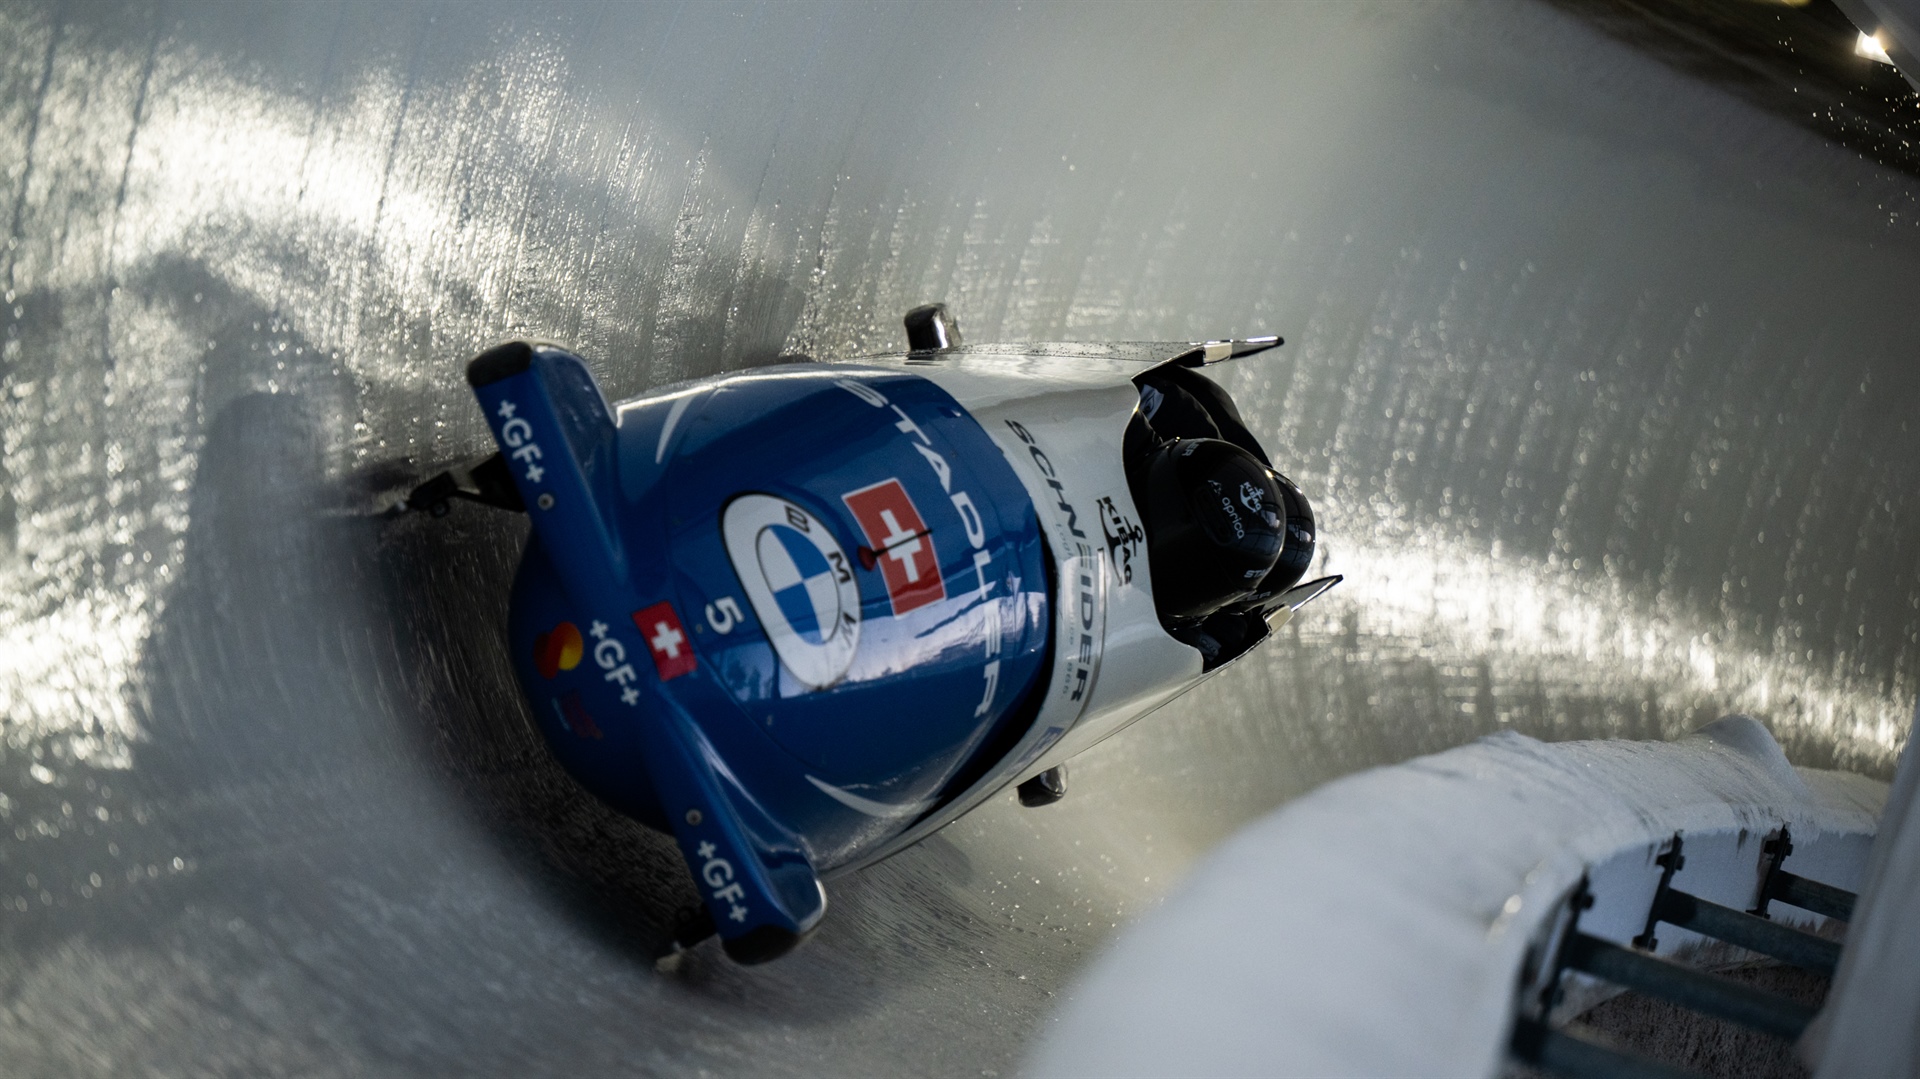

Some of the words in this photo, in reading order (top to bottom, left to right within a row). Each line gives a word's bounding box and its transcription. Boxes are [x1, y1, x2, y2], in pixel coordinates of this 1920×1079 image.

[833, 379, 1000, 718] STADLER
[1004, 418, 1094, 702] SCHNEIDER
[1102, 496, 1132, 585] KIBAG
[1221, 496, 1245, 540] aprica
[704, 595, 745, 635] 5
[784, 505, 857, 650] BMW
